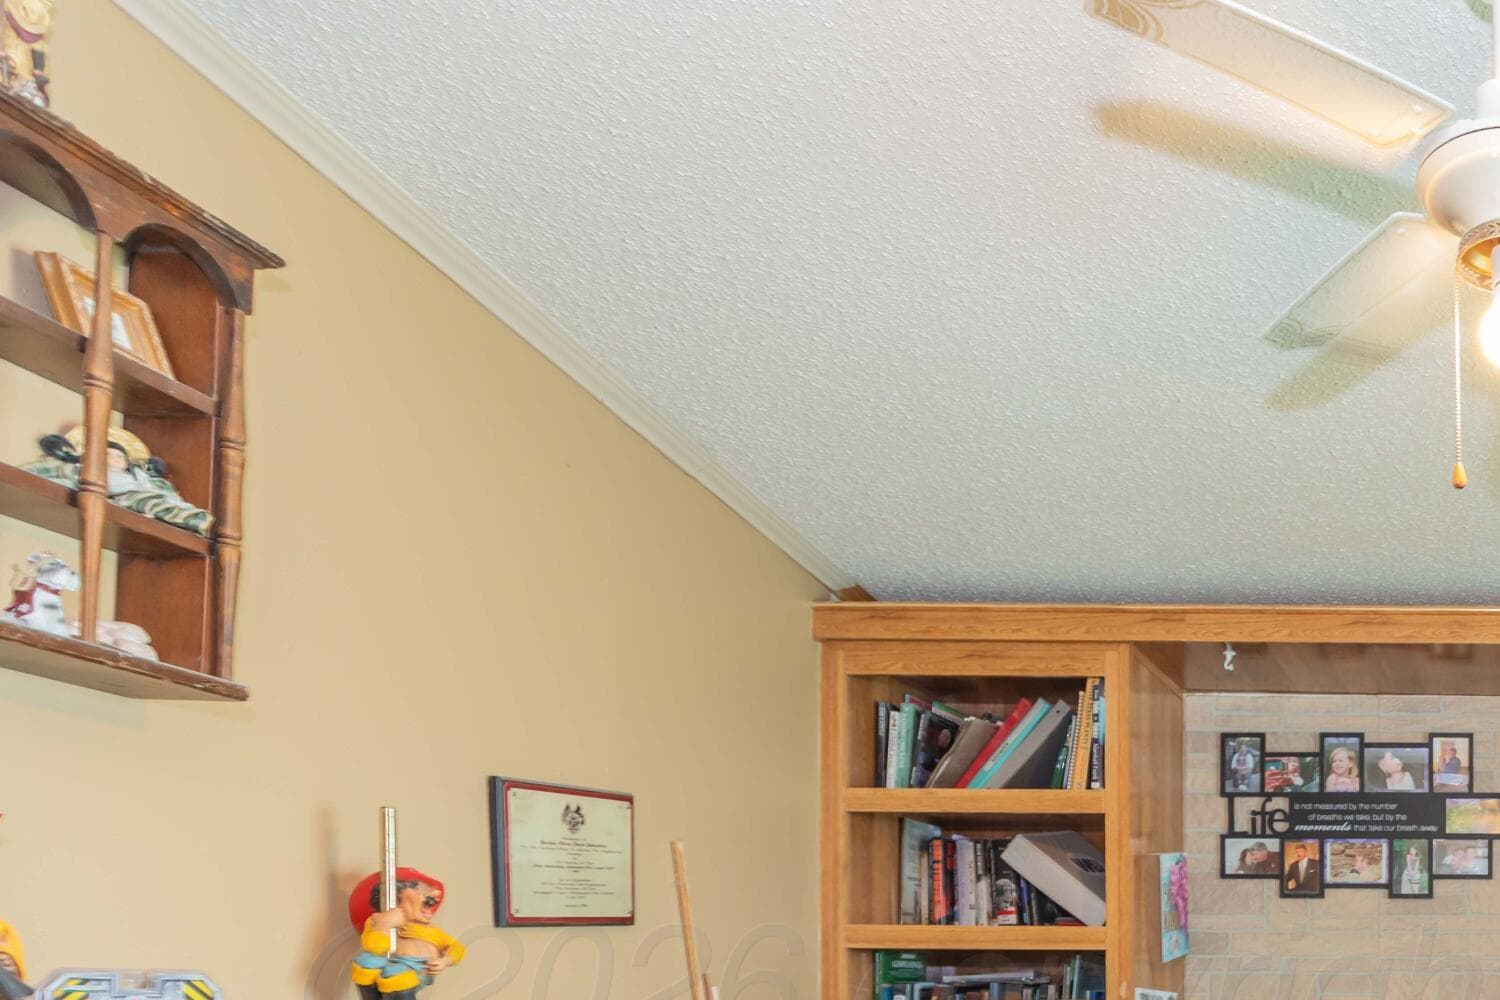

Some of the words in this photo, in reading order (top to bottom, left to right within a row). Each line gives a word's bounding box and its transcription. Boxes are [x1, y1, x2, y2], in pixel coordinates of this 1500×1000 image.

[1228, 796, 1290, 836] Life
[1294, 821, 1352, 832] moments
[1368, 824, 1383, 832] take
